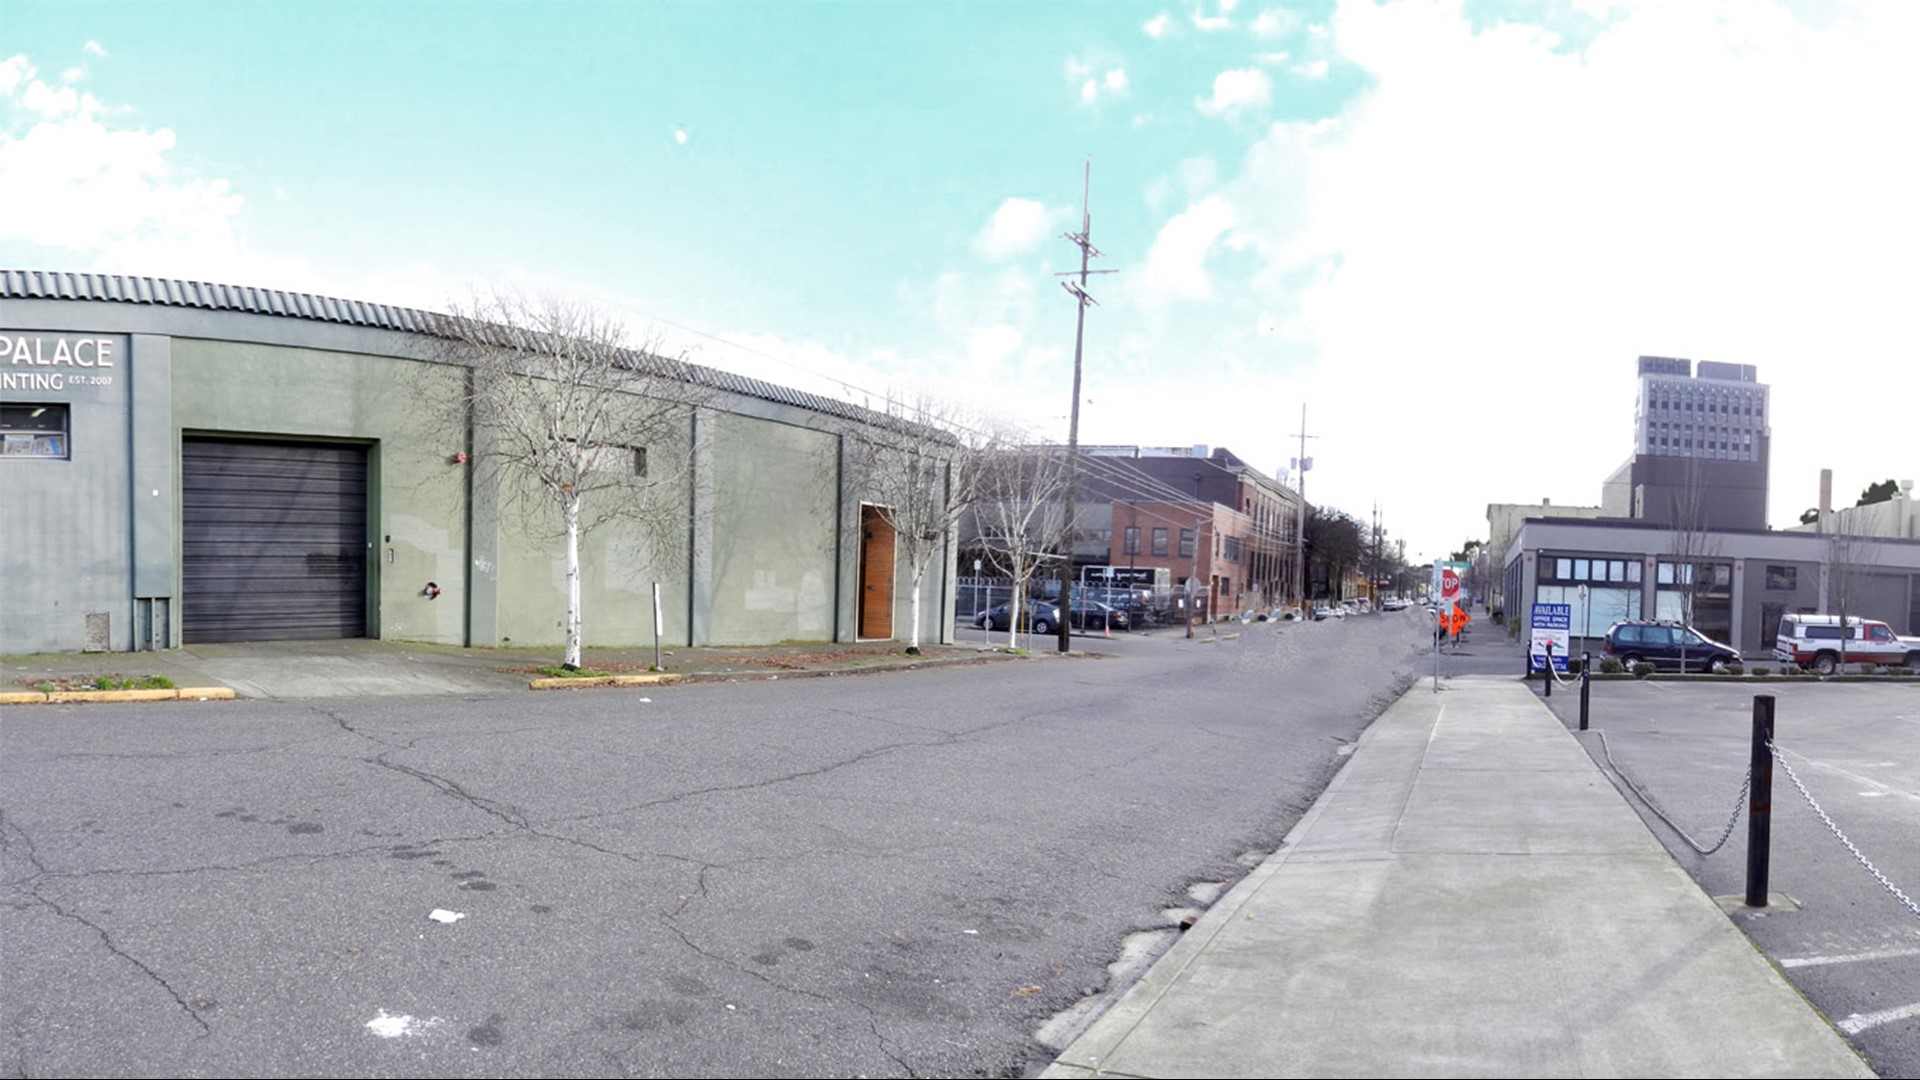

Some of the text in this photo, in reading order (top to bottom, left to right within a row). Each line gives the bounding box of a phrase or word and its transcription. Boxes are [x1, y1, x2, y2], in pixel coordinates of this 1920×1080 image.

[0, 336, 113, 367] PALACE
[68, 375, 89, 385] EST.
[90, 376, 113, 386] 2007
[1534, 605, 1569, 616] AVAILABLE
[1440, 615, 1466, 623] SOW
